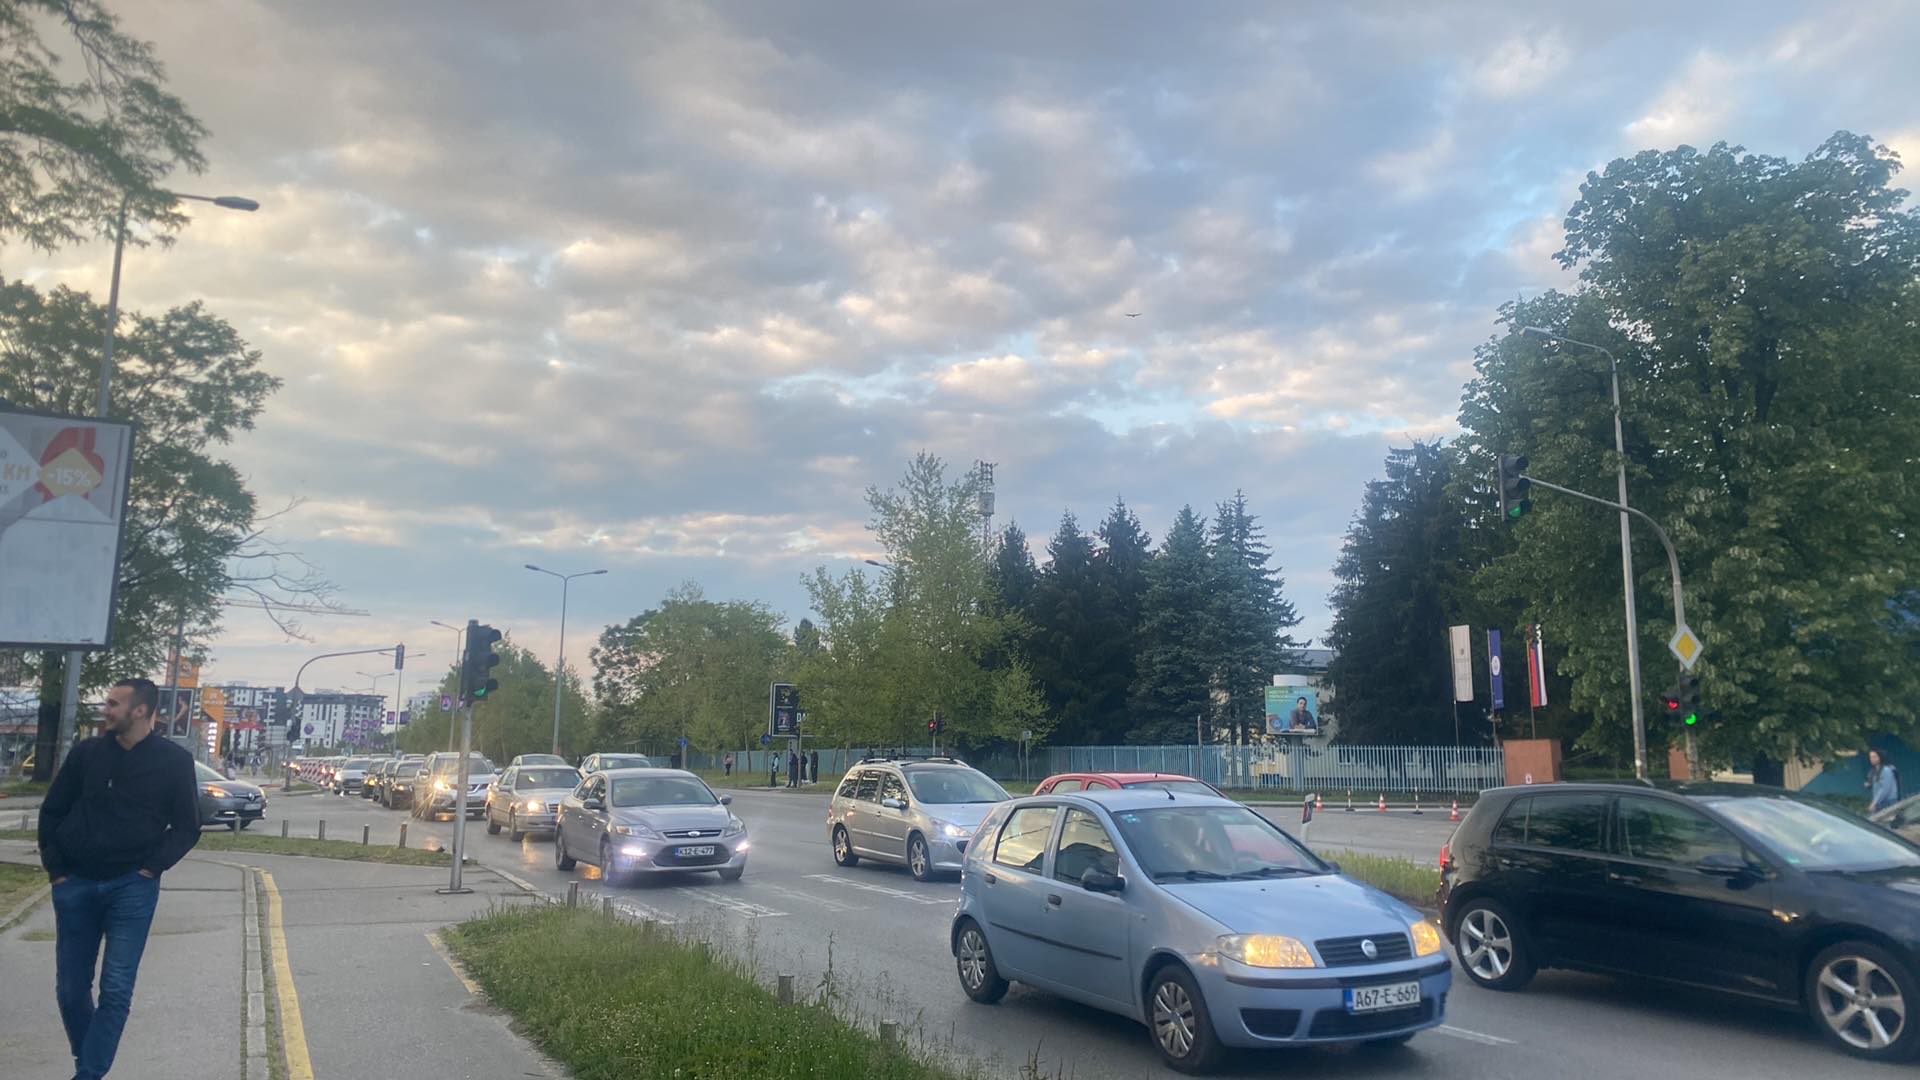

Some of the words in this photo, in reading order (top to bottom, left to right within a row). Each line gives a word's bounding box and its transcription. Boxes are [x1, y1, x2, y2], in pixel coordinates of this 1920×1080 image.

[3, 463, 32, 480] KM
[48, 467, 92, 488] -15%
[1355, 984, 1418, 1008] A67-E-669
